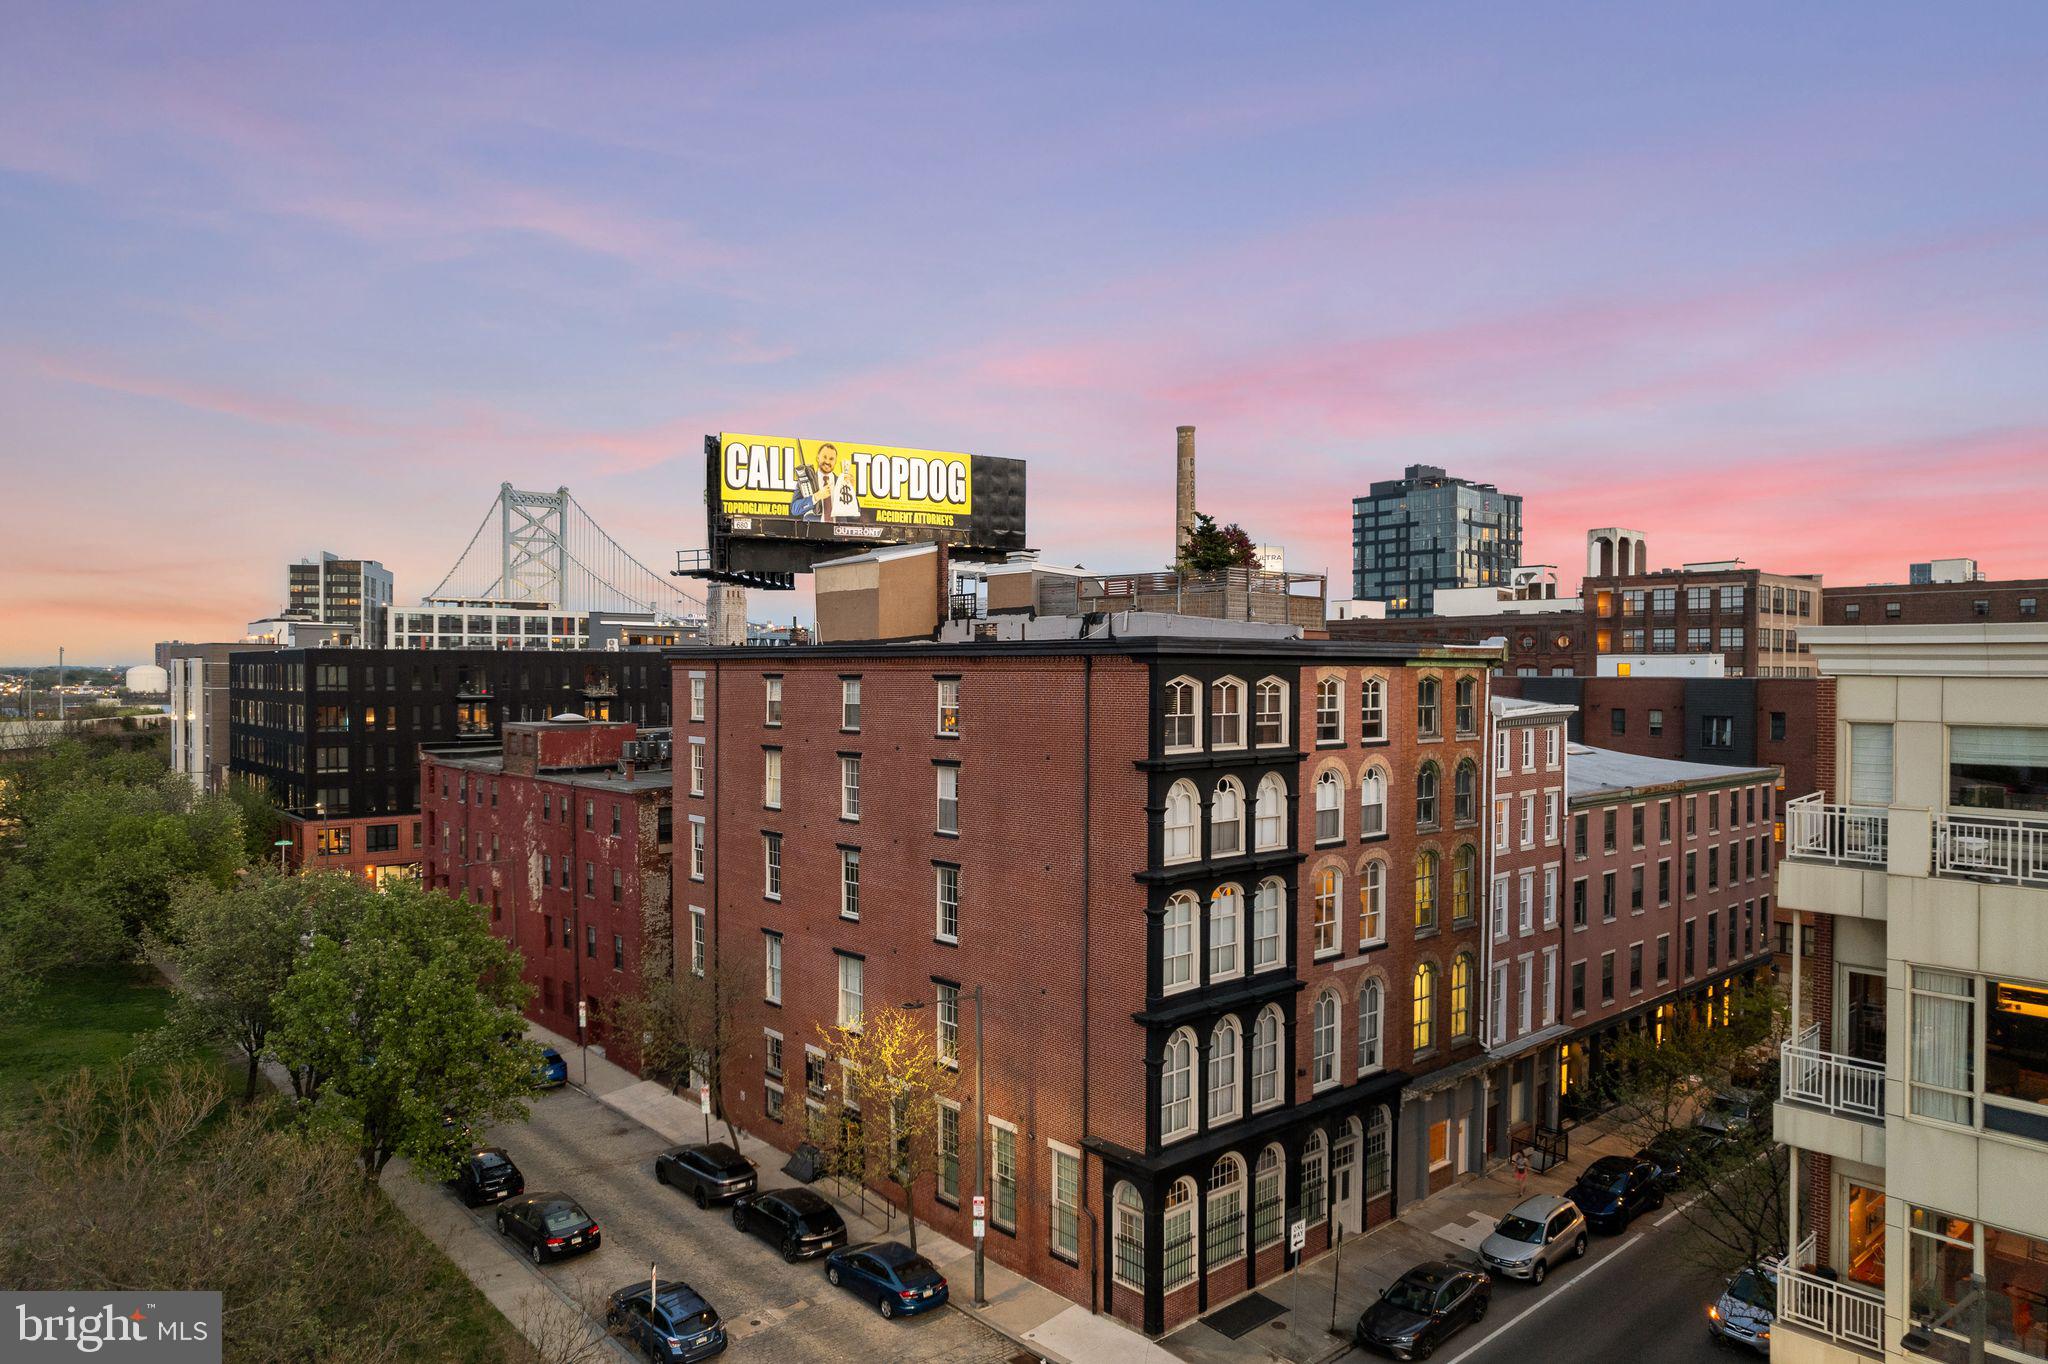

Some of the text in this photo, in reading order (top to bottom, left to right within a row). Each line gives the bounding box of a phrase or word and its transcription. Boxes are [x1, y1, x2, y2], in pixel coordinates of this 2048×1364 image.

[725, 442, 967, 504] CALL TOPDOG
[723, 501, 790, 516] TOPDOGLAW.COM
[876, 509, 954, 526] ACCIDENT ATTORNEYS
[834, 526, 882, 537] OUTFRONT
